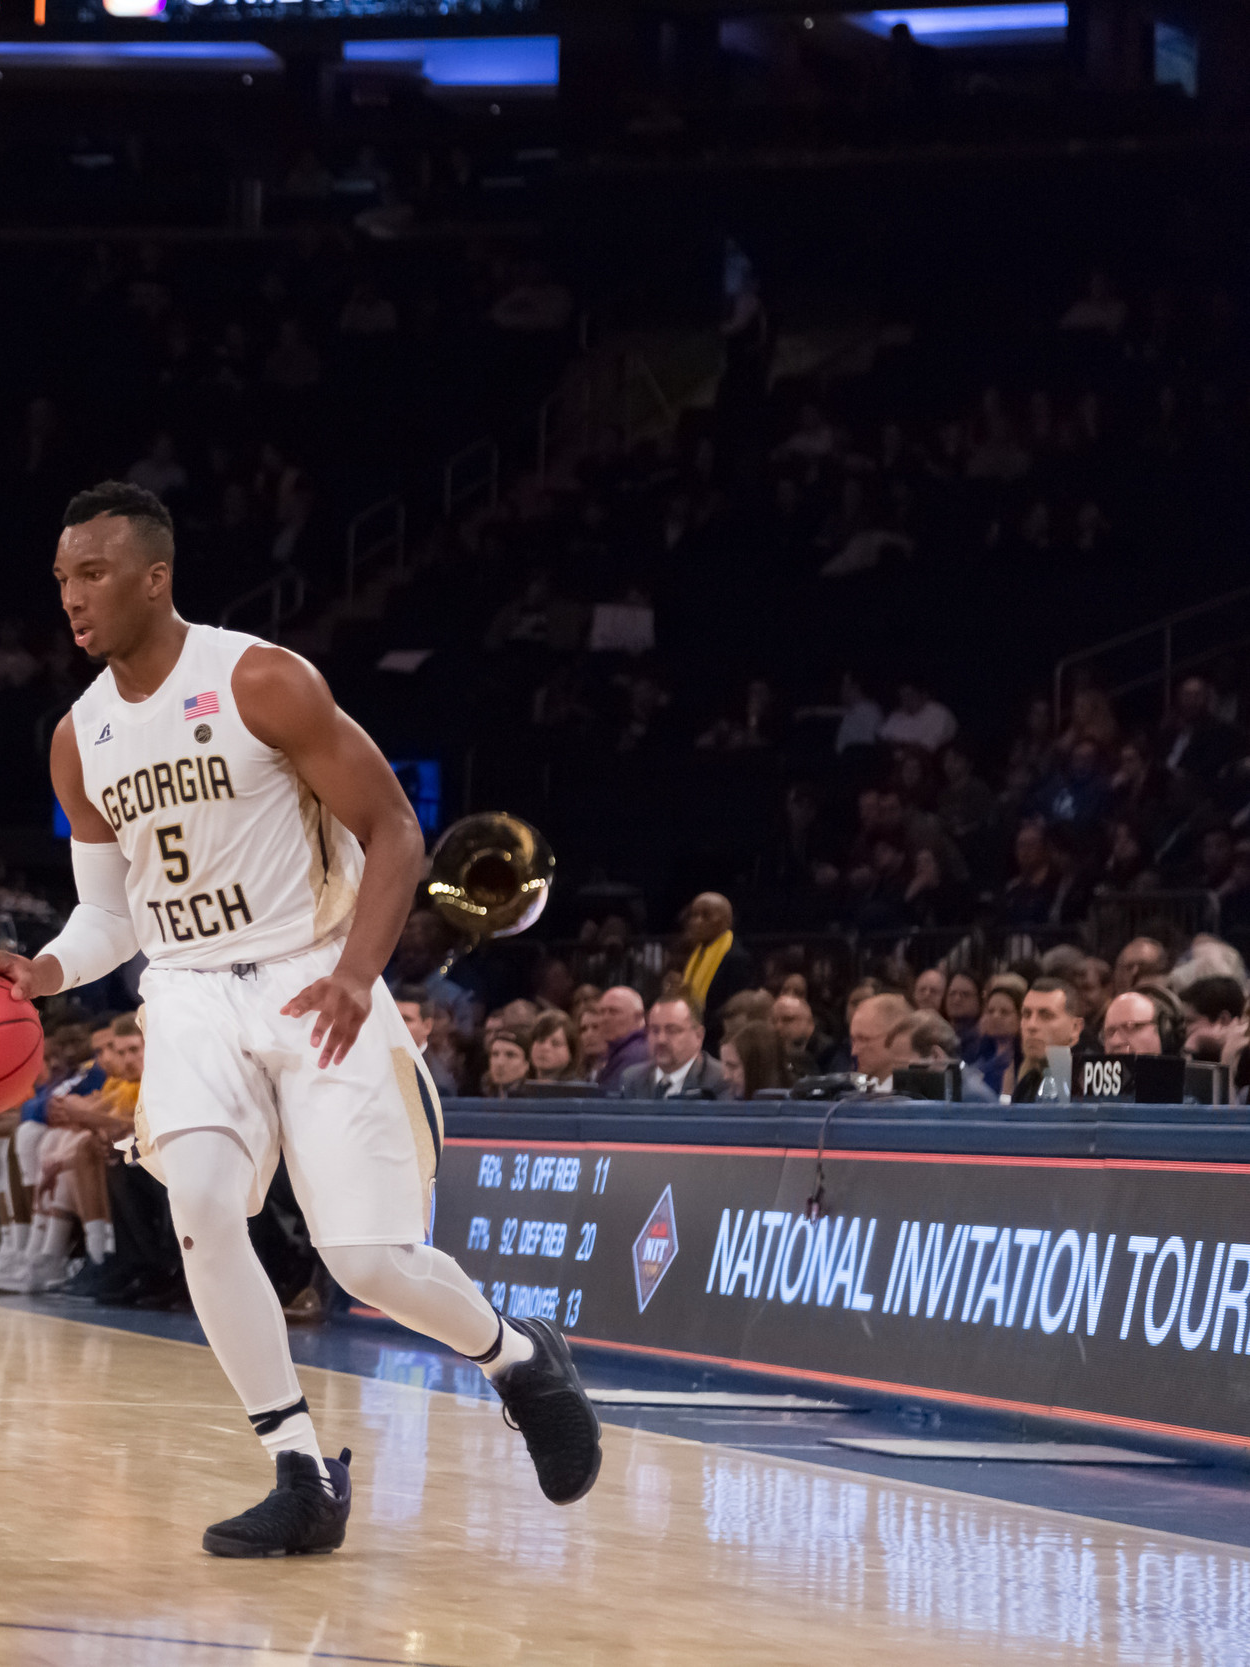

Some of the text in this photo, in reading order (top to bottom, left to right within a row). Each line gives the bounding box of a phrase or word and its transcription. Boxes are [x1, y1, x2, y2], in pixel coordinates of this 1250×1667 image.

[101, 756, 237, 832] GEORGIA
[155, 822, 190, 886] 5
[146, 882, 253, 944] TECH
[1083, 1061, 1122, 1096] POSS
[509, 1153, 530, 1191] 33
[530, 1156, 557, 1190] OFF
[592, 1156, 611, 1195] 11
[498, 1217, 519, 1256] 92
[517, 1220, 545, 1255] DEF
[575, 1222, 598, 1262] 20
[642, 1237, 670, 1263] NIT
[705, 1208, 1250, 1356] NATIONAL INVITATION TOUR
[563, 1288, 582, 1328] 13
